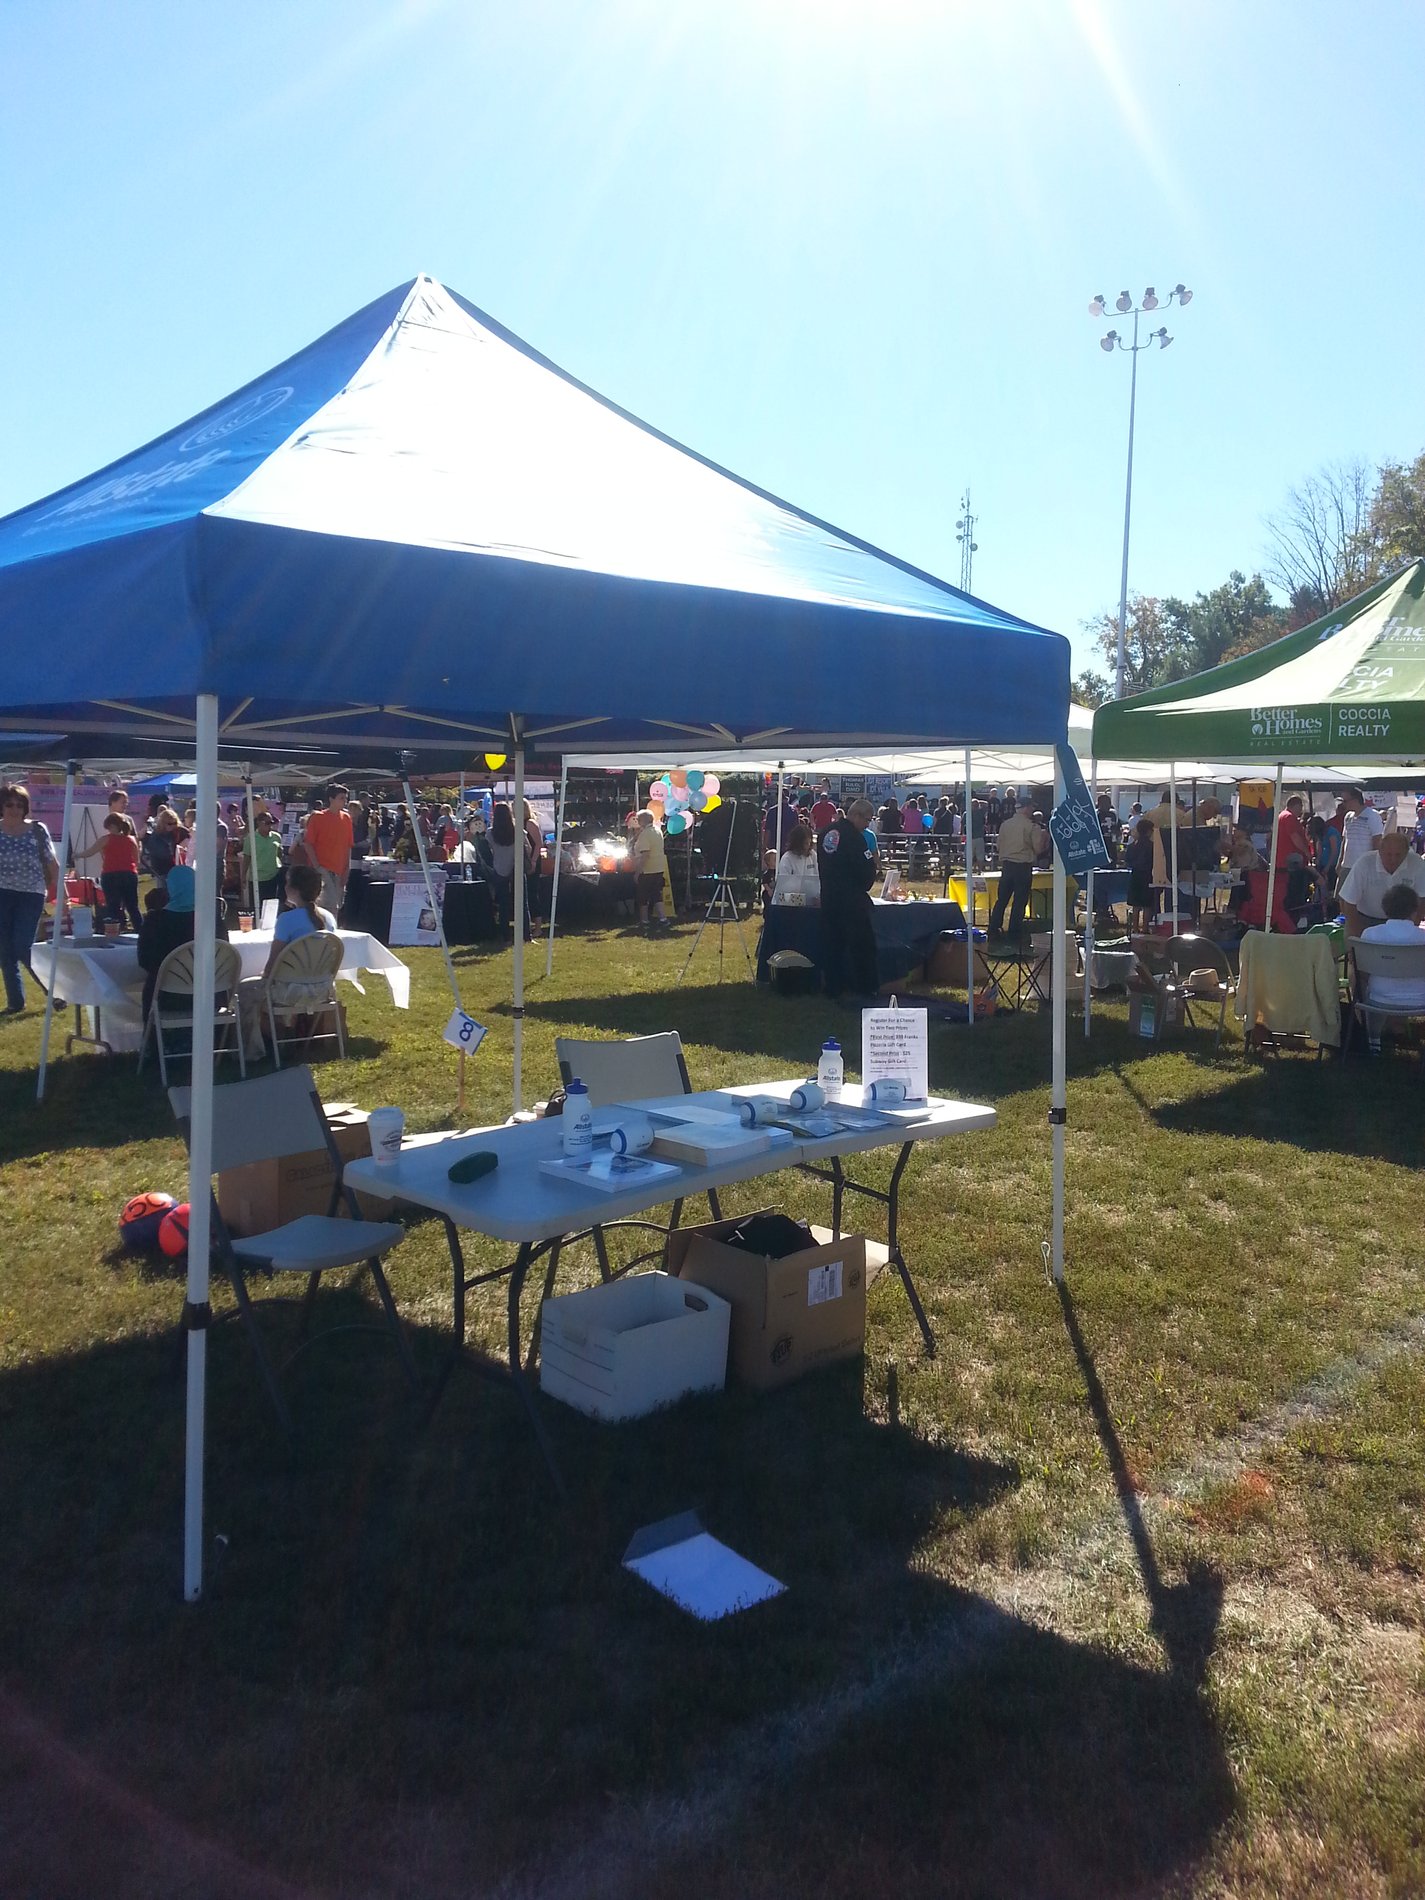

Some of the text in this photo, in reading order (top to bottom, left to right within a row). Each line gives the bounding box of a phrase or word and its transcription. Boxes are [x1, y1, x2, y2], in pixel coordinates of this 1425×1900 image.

[1250, 707, 1298, 721] Better
[1338, 708, 1392, 720] COCCIA
[1265, 717, 1323, 736] Homes
[1338, 724, 1391, 737] REALTY
[459, 1021, 474, 1042] 8
